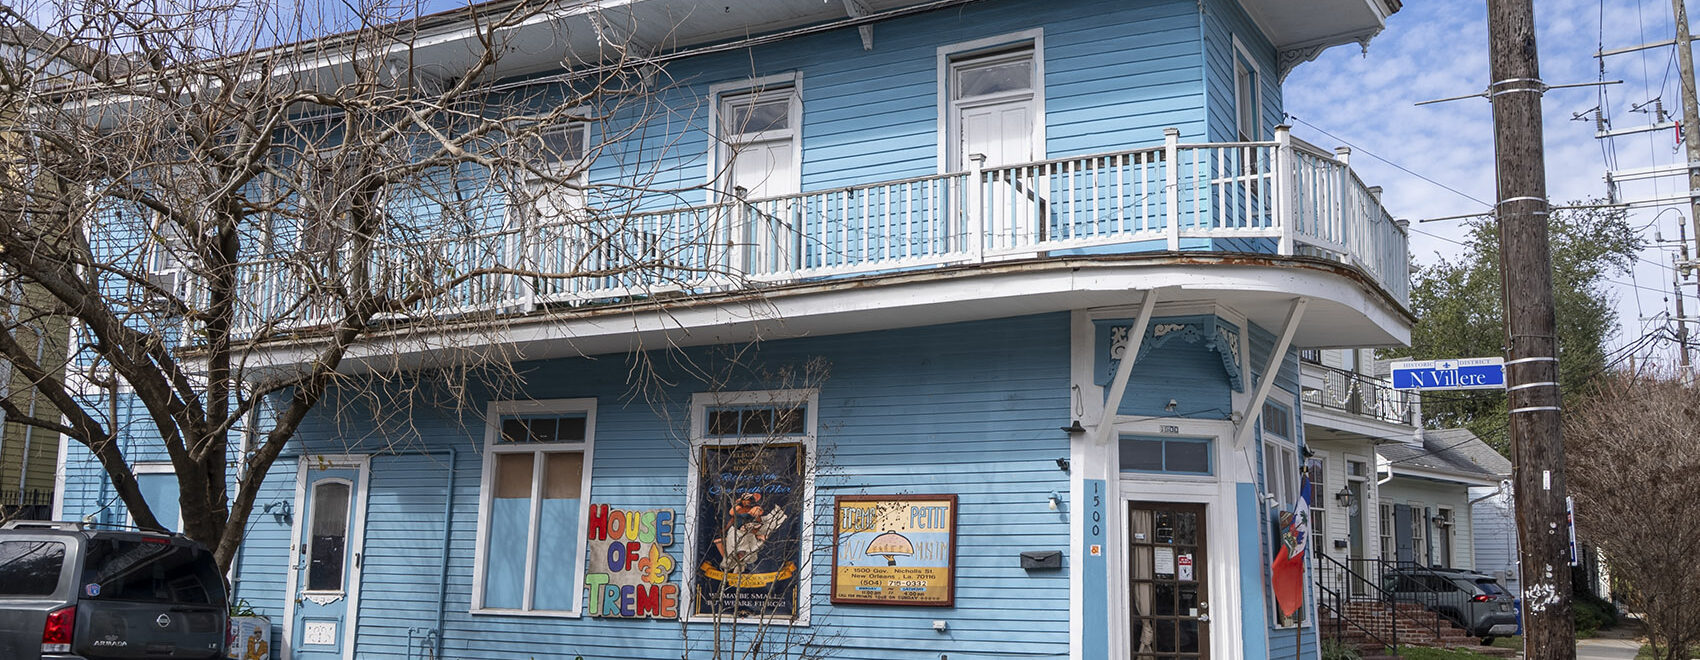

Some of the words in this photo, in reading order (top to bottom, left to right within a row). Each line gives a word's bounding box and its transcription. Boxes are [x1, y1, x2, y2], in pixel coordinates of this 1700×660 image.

[1410, 371, 1424, 387] N
[1430, 370, 1486, 386] Villere
[588, 504, 672, 544] HOUSE
[1092, 482, 1100, 536] 1500
[607, 541, 641, 572] OF
[586, 573, 678, 617] TREME
